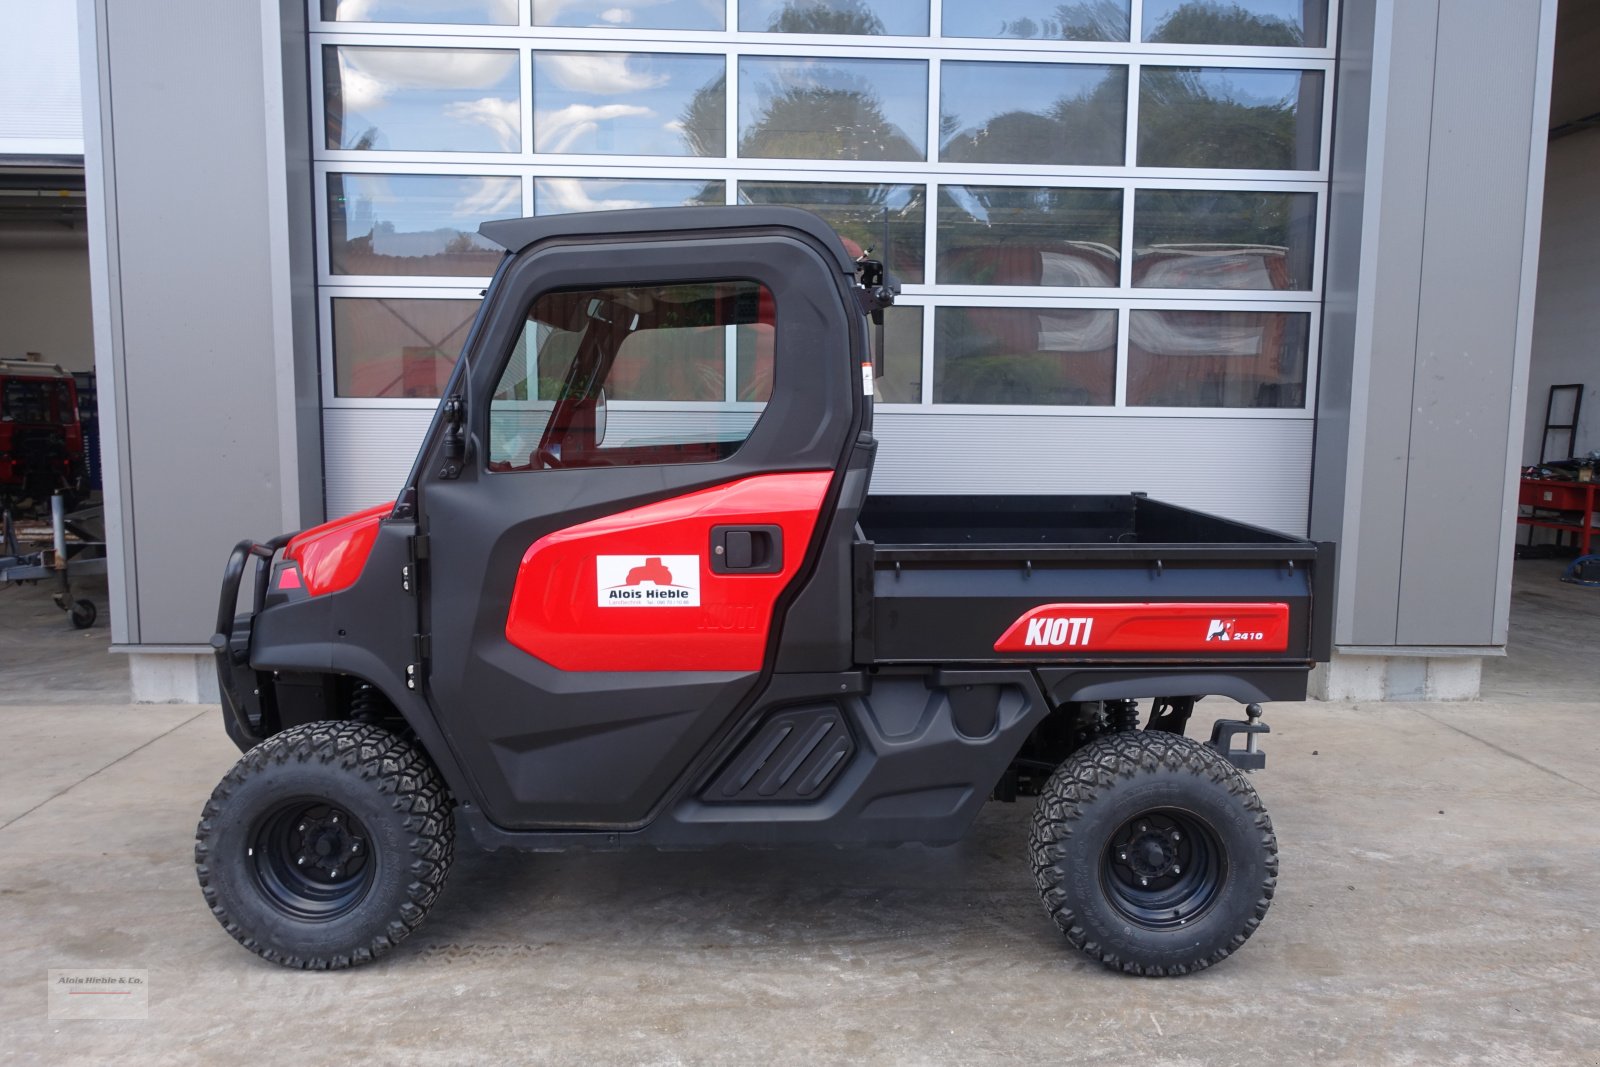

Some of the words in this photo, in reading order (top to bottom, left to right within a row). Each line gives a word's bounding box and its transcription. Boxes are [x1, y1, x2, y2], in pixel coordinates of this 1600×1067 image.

[609, 590, 642, 599] Alois
[646, 589, 689, 599] Hieble
[1024, 617, 1094, 646] KIOTI
[1233, 632, 1263, 641] 2410
